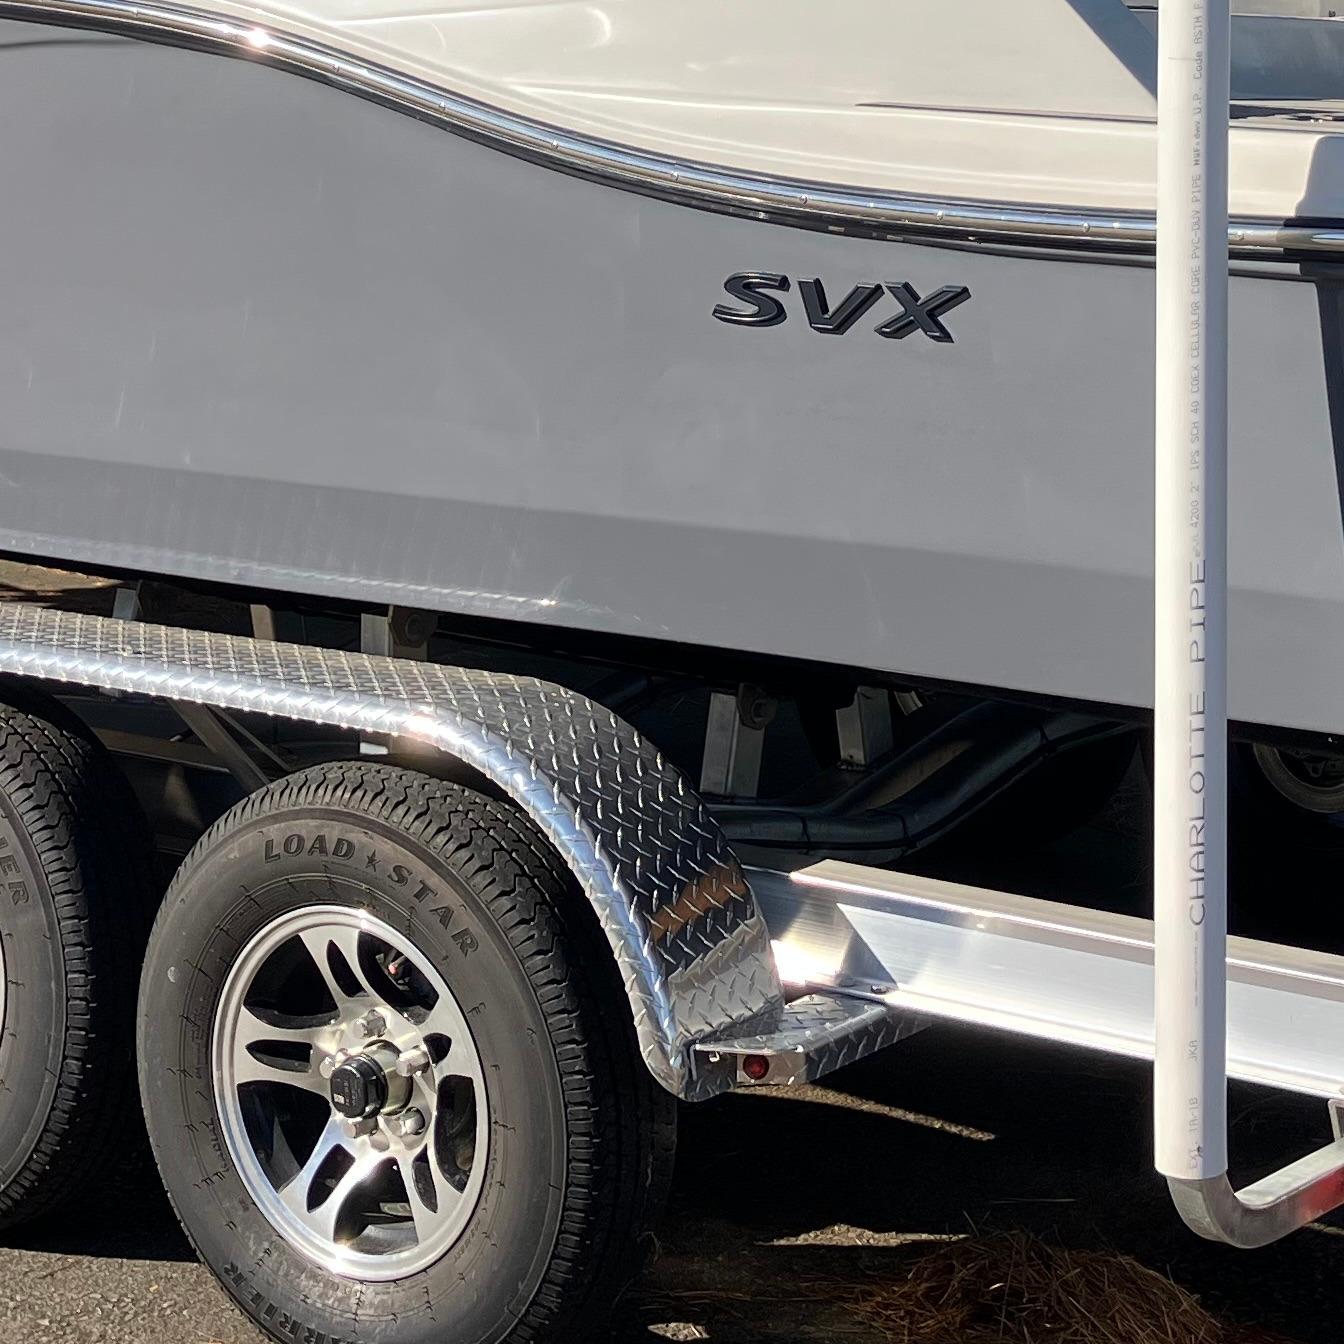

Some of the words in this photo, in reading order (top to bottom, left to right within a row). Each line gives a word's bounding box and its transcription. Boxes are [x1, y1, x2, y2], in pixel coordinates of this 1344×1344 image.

[1193, 16, 1203, 45] ASTM
[1192, 174, 1201, 203] PIPE
[1191, 265, 1200, 295] CORE
[712, 272, 972, 344] SVX
[1191, 301, 1199, 359] CELLULAR
[1191, 365, 1199, 394] COEX
[1190, 400, 1199, 415] 40
[1190, 421, 1199, 444] SCH
[1189, 560, 1205, 664] PIPE
[1189, 692, 1205, 926] CHARLOTTE
[264, 832, 356, 864] LOAD
[387, 864, 480, 957] STAR
